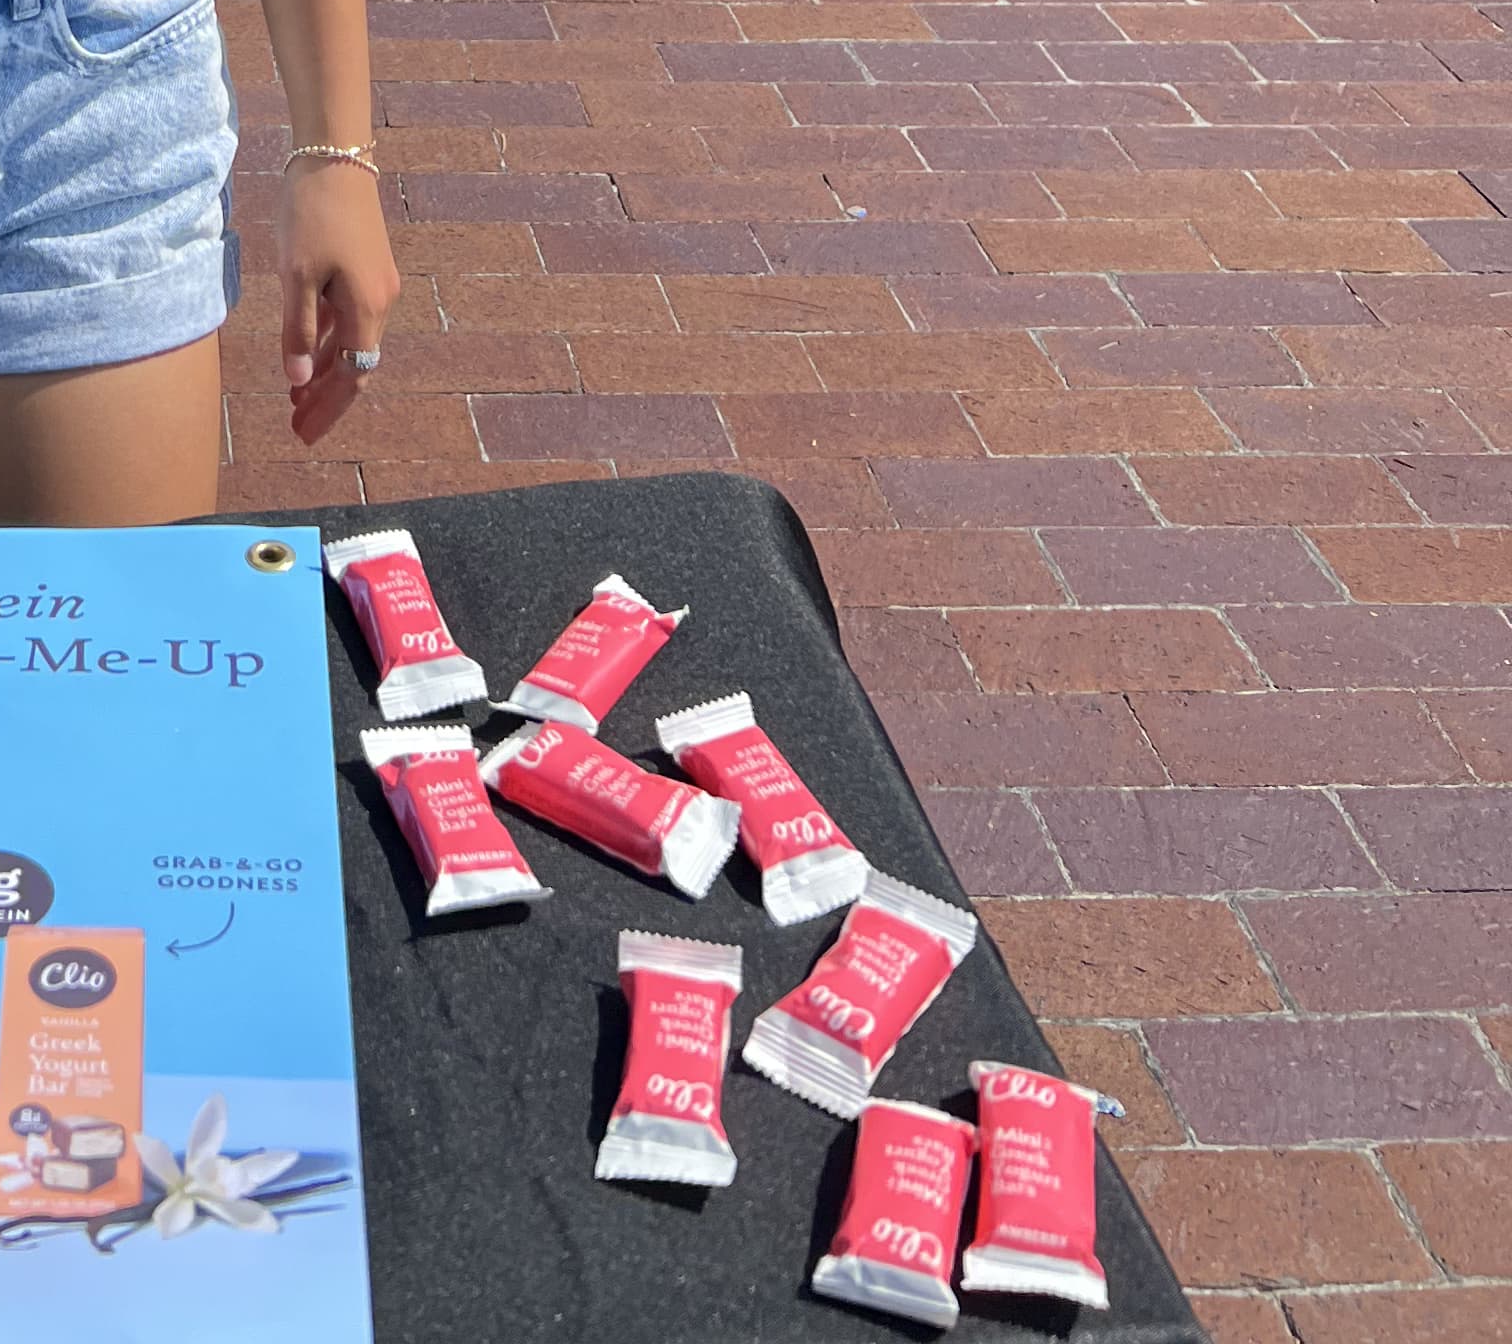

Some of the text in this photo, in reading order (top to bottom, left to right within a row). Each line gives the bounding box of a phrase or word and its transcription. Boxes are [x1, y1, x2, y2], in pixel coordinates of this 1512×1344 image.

[741, 766, 789, 786] Greek
[426, 779, 464, 795] Mini
[757, 780, 798, 801] Mini
[428, 791, 475, 807] Greek
[439, 817, 477, 834] Bars
[772, 811, 833, 844] Clio
[152, 855, 303, 873] GRAB-&-GO
[157, 874, 299, 892] GOODNESS
[40, 961, 105, 990] Clio
[40, 1016, 100, 1027] VANILLA
[809, 984, 875, 1040] Clio
[29, 1032, 101, 1052] Greek
[664, 1035, 709, 1057] Mini
[29, 1053, 109, 1076] Yogurt
[28, 1074, 68, 1095] Bar
[984, 1073, 1057, 1109] Clio
[647, 1073, 716, 1118] Clio
[994, 1126, 1042, 1147] Mini
[871, 1217, 944, 1268] Clio
